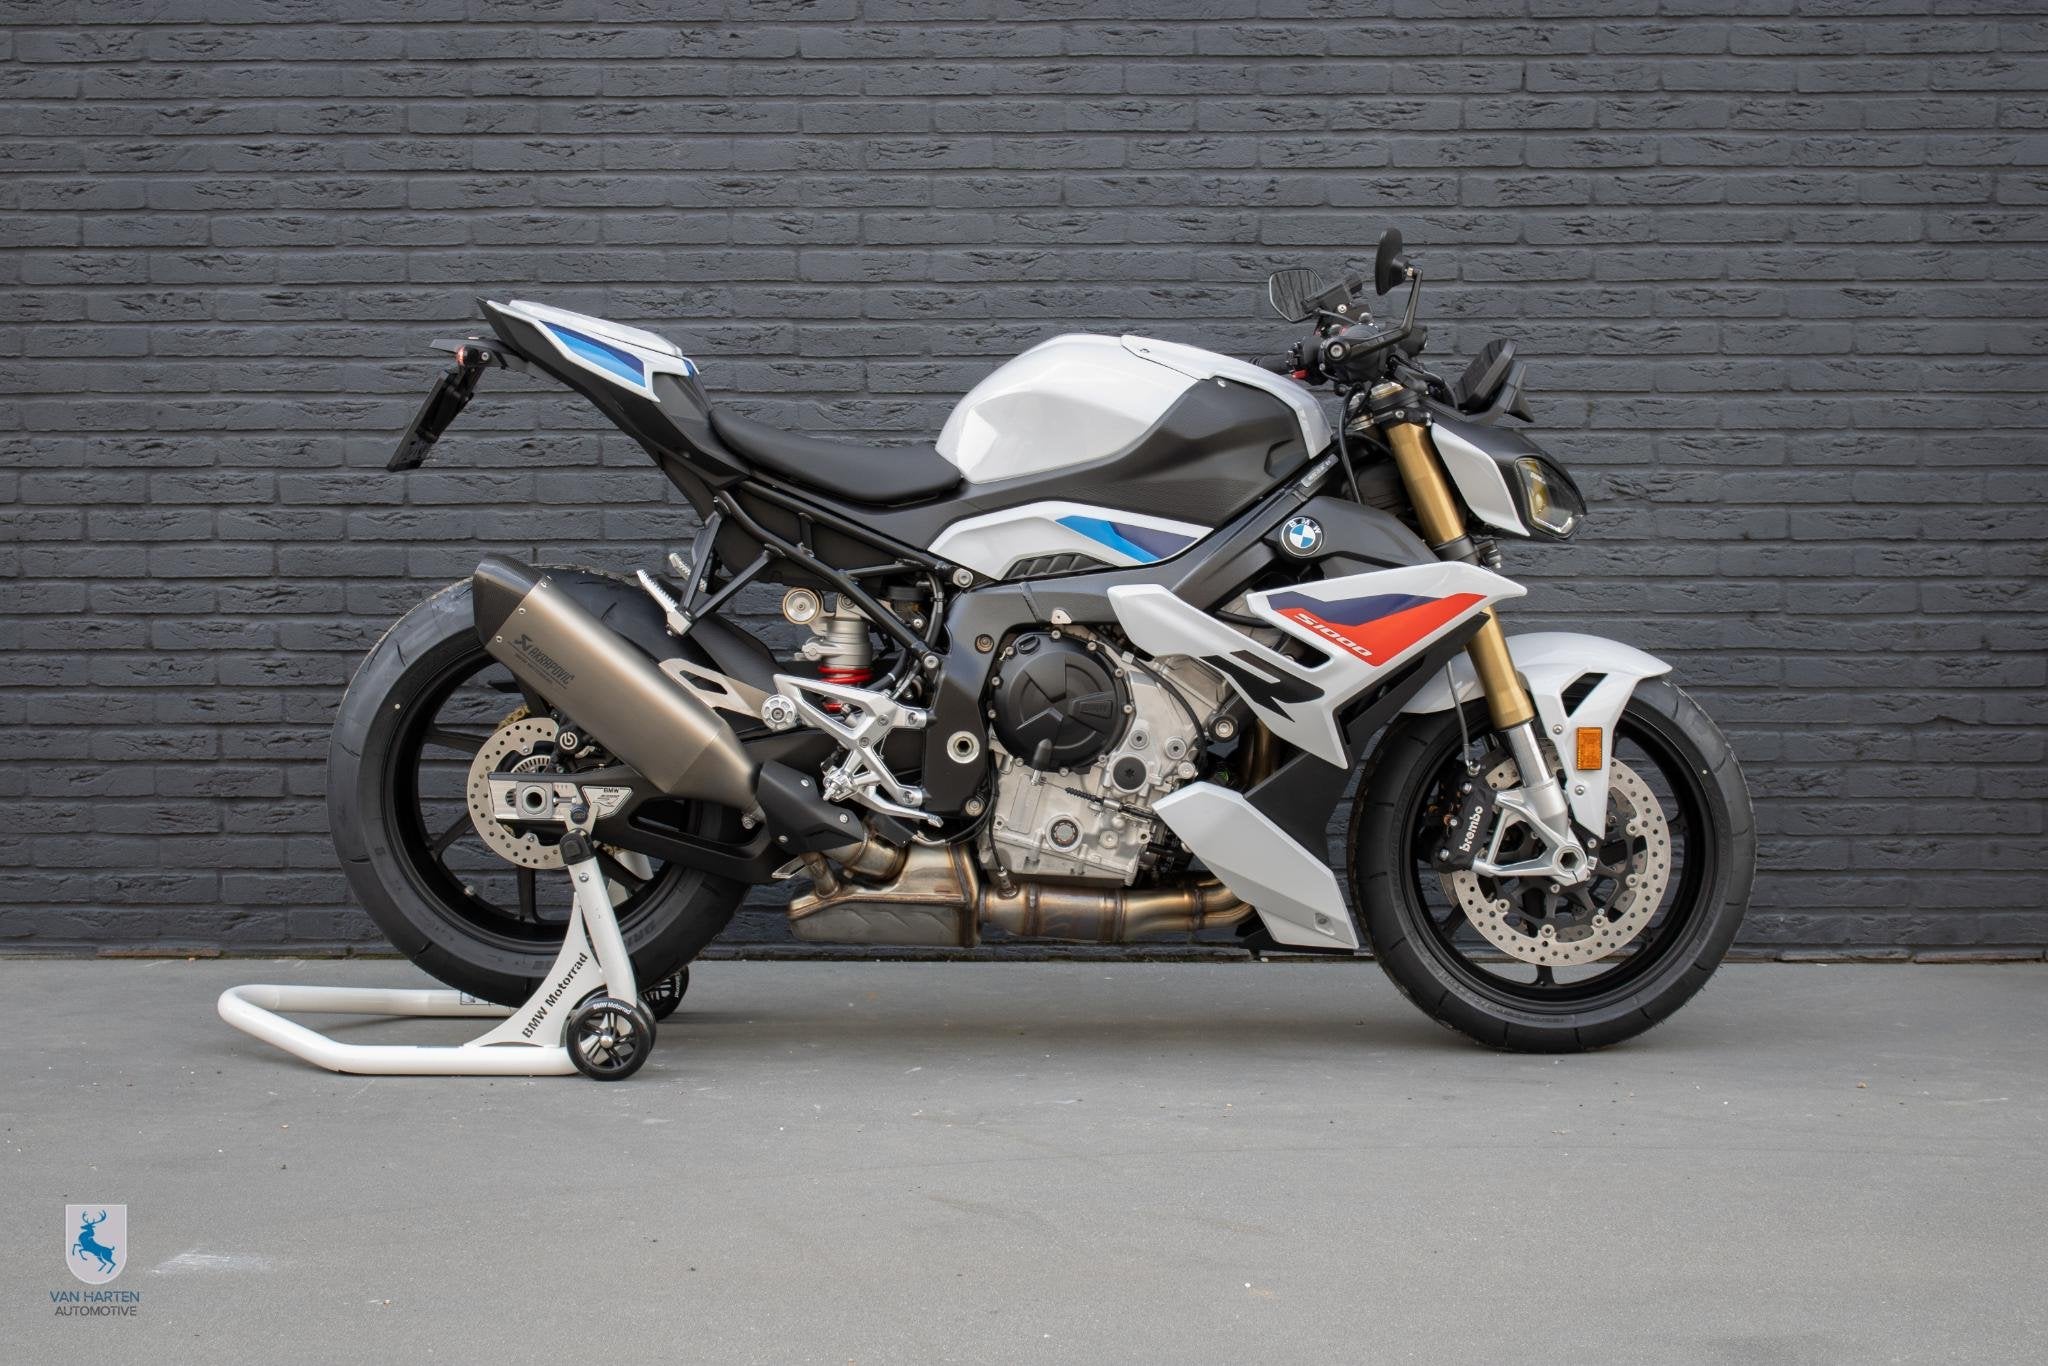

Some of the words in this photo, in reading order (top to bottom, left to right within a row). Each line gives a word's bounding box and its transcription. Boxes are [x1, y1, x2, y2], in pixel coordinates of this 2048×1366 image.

[1289, 519, 1321, 534] BMW
[1294, 613, 1373, 657] S1000
[1459, 805, 1484, 852] brembo
[521, 1006, 548, 1039] BMW
[545, 952, 589, 1007] Motorrad
[592, 1002, 608, 1010] BMW
[608, 1002, 632, 1015] Motorrad
